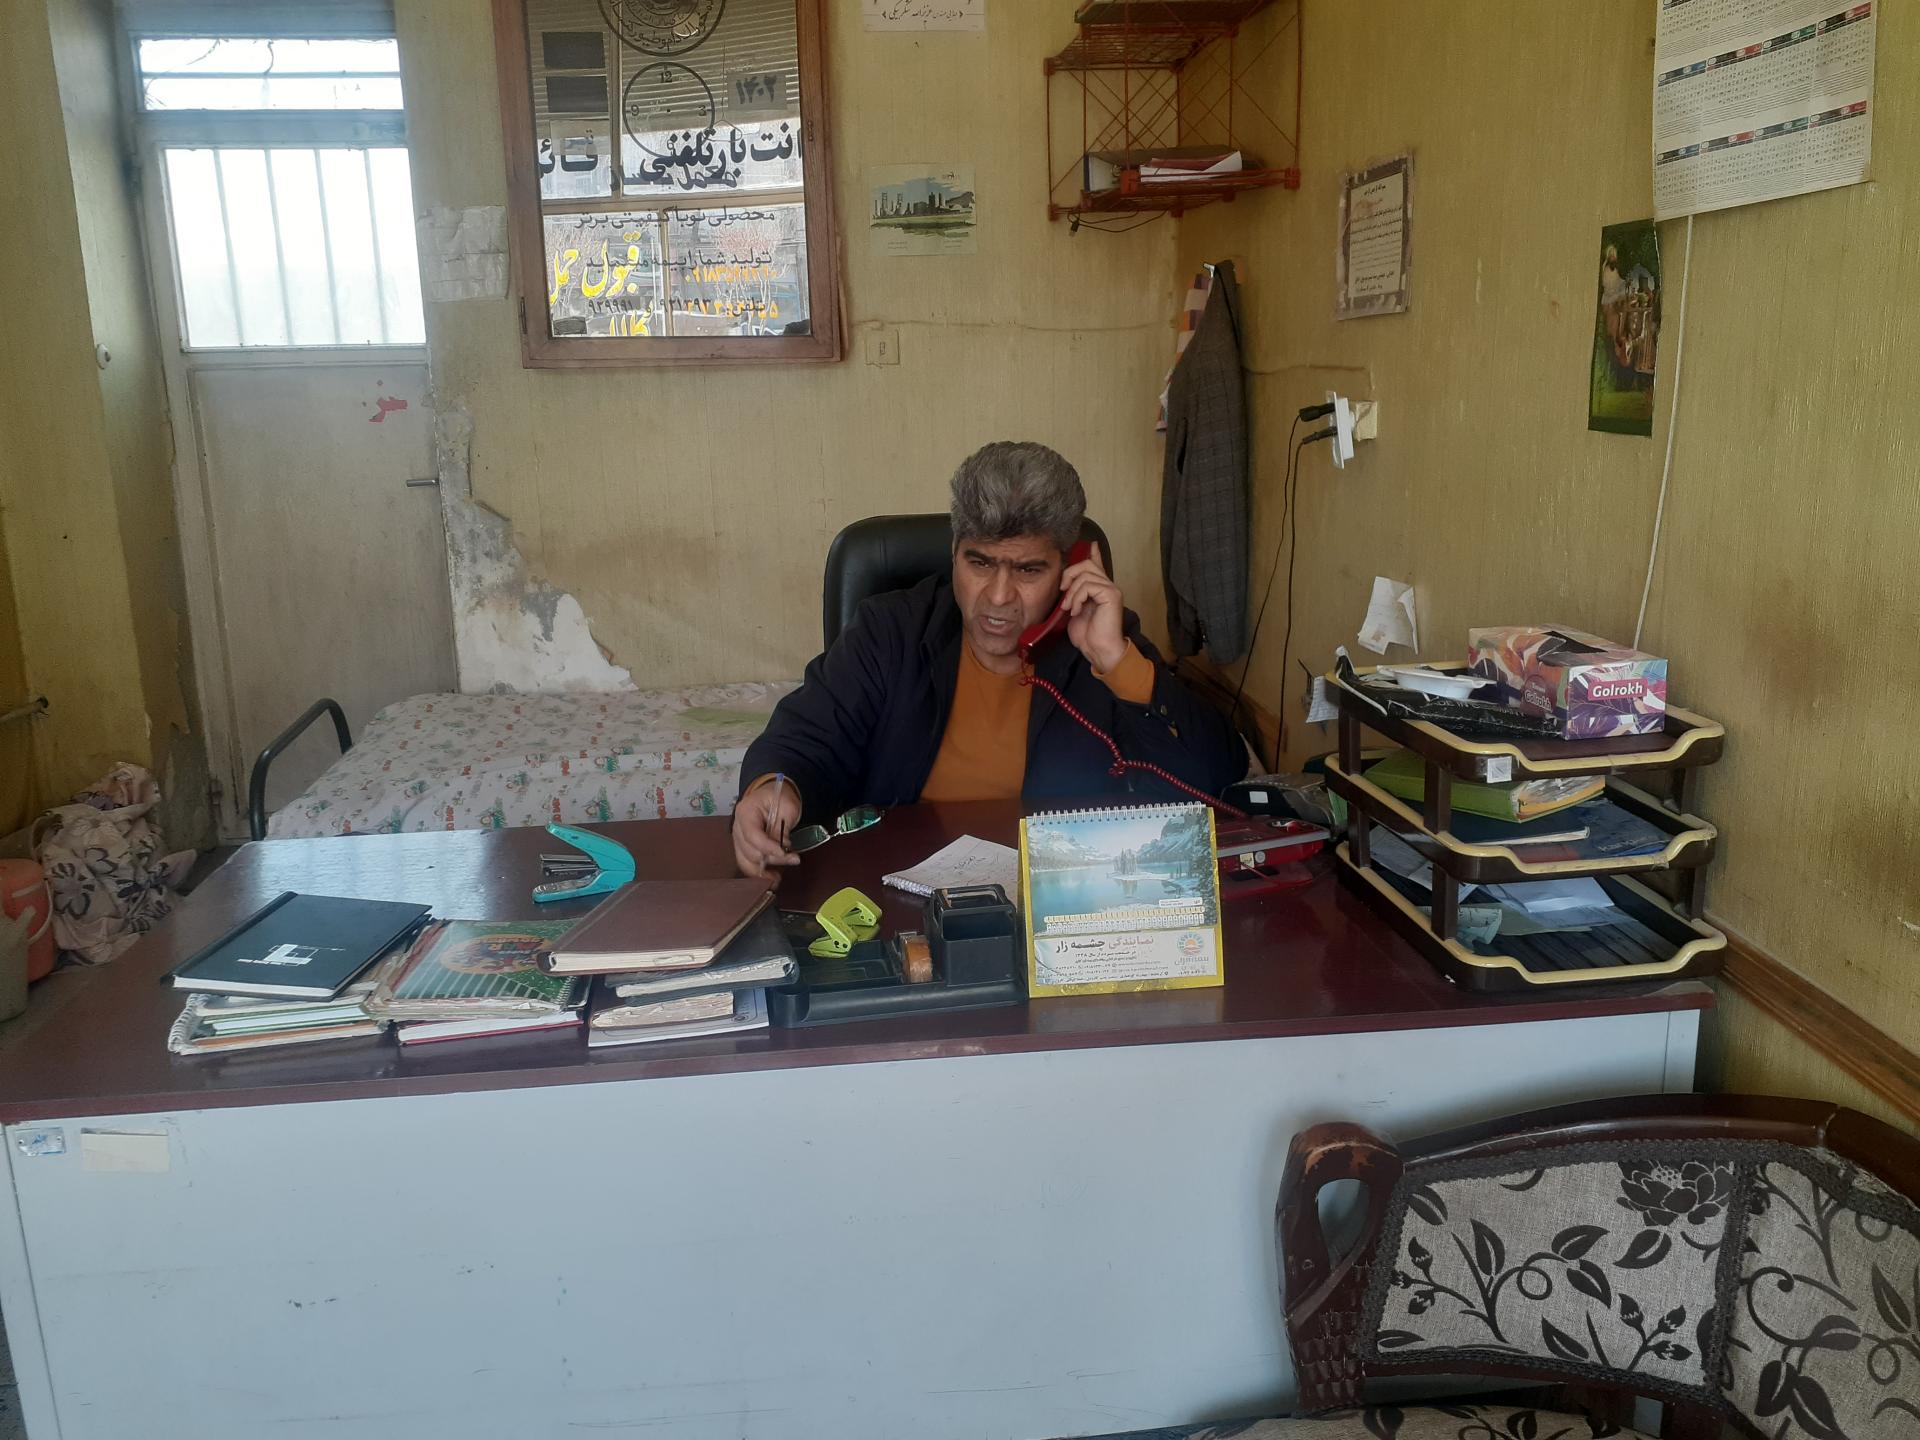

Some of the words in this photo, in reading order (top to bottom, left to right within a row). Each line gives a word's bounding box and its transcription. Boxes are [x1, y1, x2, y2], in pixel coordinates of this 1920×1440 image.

[660, 71, 673, 83] 12
[631, 104, 640, 116] 9
[698, 104, 707, 116] 3
[639, 128, 717, 180] تلفنی
[574, 212, 609, 229] برتر
[708, 206, 775, 227] محصولی
[581, 231, 642, 299] قبول
[730, 247, 772, 268] تولید
[1592, 681, 1643, 698] Golrokh
[1056, 940, 1069, 954] زار
[1070, 938, 1105, 951] چشمه
